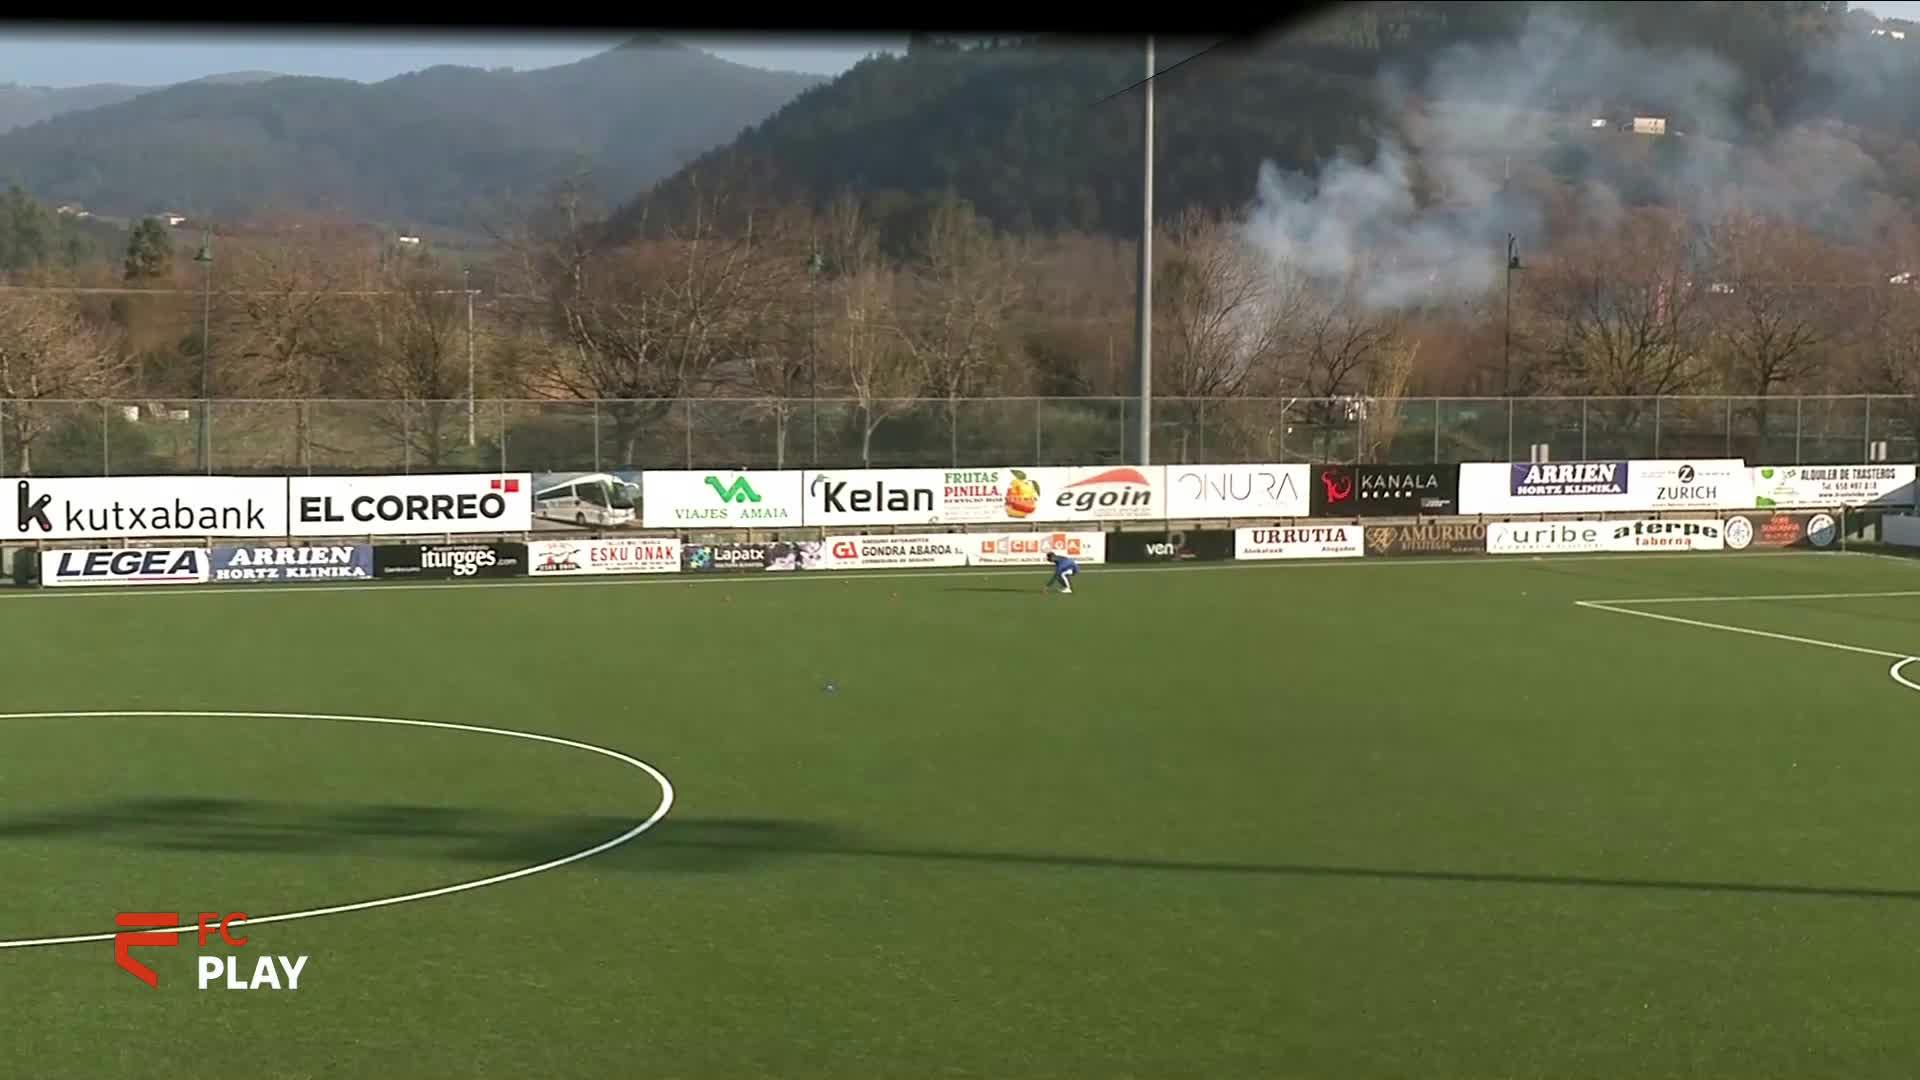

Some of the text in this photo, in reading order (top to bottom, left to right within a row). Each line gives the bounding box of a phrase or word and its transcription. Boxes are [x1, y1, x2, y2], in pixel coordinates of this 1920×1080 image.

[944, 472, 999, 484] FRUTAS
[1361, 474, 1438, 489] KANALA
[1524, 464, 1616, 484] ARRIEN
[1840, 469, 1849, 479] DE
[824, 481, 933, 512] Kelan
[1517, 484, 1621, 495] HORTZ KLINIKA
[1656, 485, 1717, 500] ZURICH
[300, 492, 506, 522] EL CORREO
[1056, 486, 1151, 512] egoin
[66, 498, 265, 531] kutxabank
[675, 508, 788, 519] VIAJES AMAIA
[1252, 528, 1347, 544] URRUTIA
[1400, 525, 1486, 541] AMURRIO
[1513, 524, 1597, 543] uribe
[1614, 521, 1718, 539] aterpe
[229, 547, 354, 566] ARRIEN
[591, 546, 674, 562] ESKU ONAK
[714, 548, 765, 564] Lapatx
[862, 545, 906, 556] GONDRA
[909, 545, 951, 555] ABAROA
[56, 551, 199, 577] LEGEA
[217, 567, 365, 579] HORTZ KLINIKA
